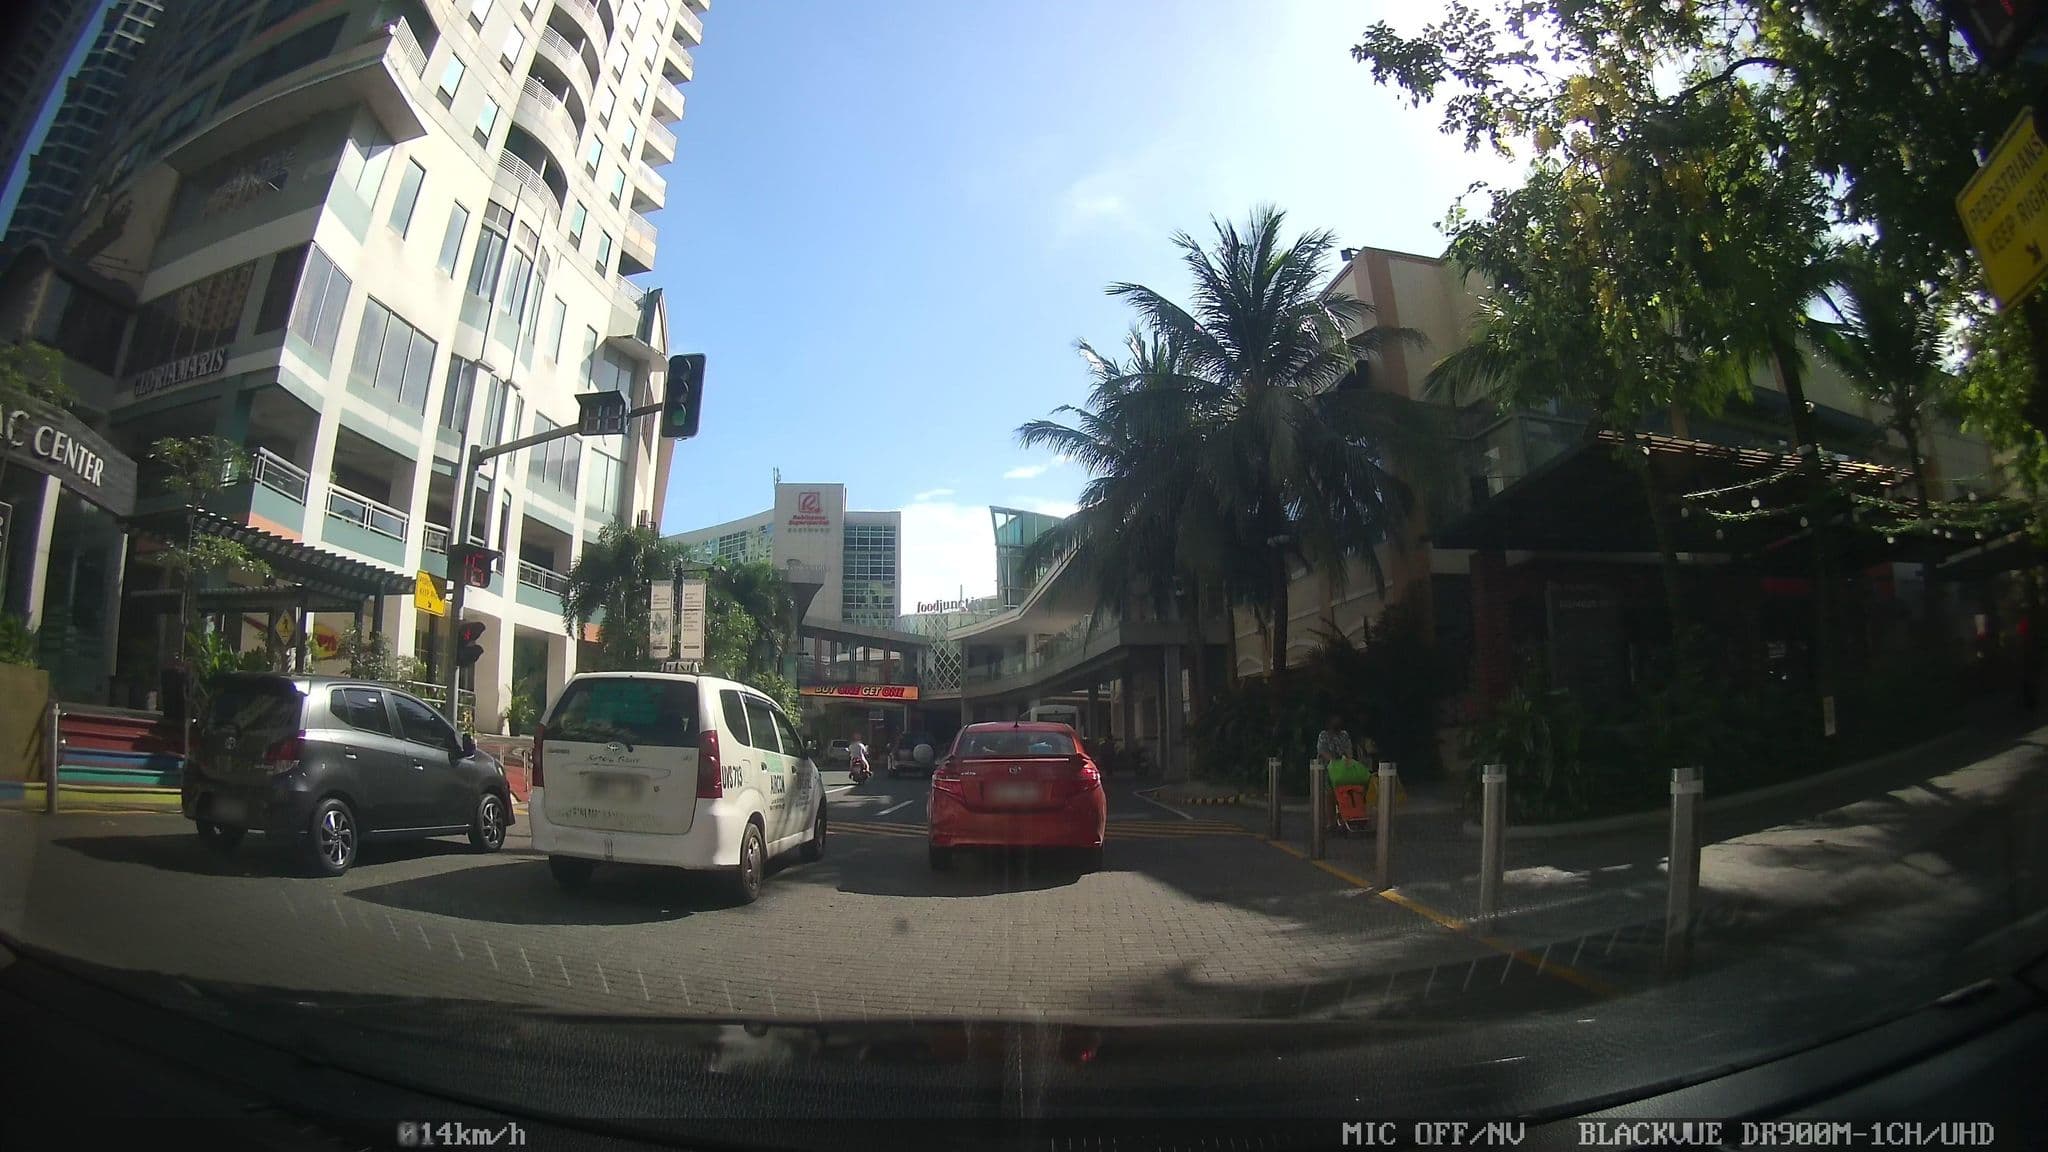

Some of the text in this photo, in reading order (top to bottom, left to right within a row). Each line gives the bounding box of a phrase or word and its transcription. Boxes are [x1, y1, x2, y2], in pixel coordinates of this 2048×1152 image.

[1967, 136, 2044, 225] PEDESTRIANS
[1987, 214, 2017, 254] KEEP
[33, 425, 104, 487] CENTER
[815, 686, 835, 694] BUY
[862, 686, 882, 696] GET
[882, 686, 905, 697] ONE
[721, 765, 743, 789] UVS713
